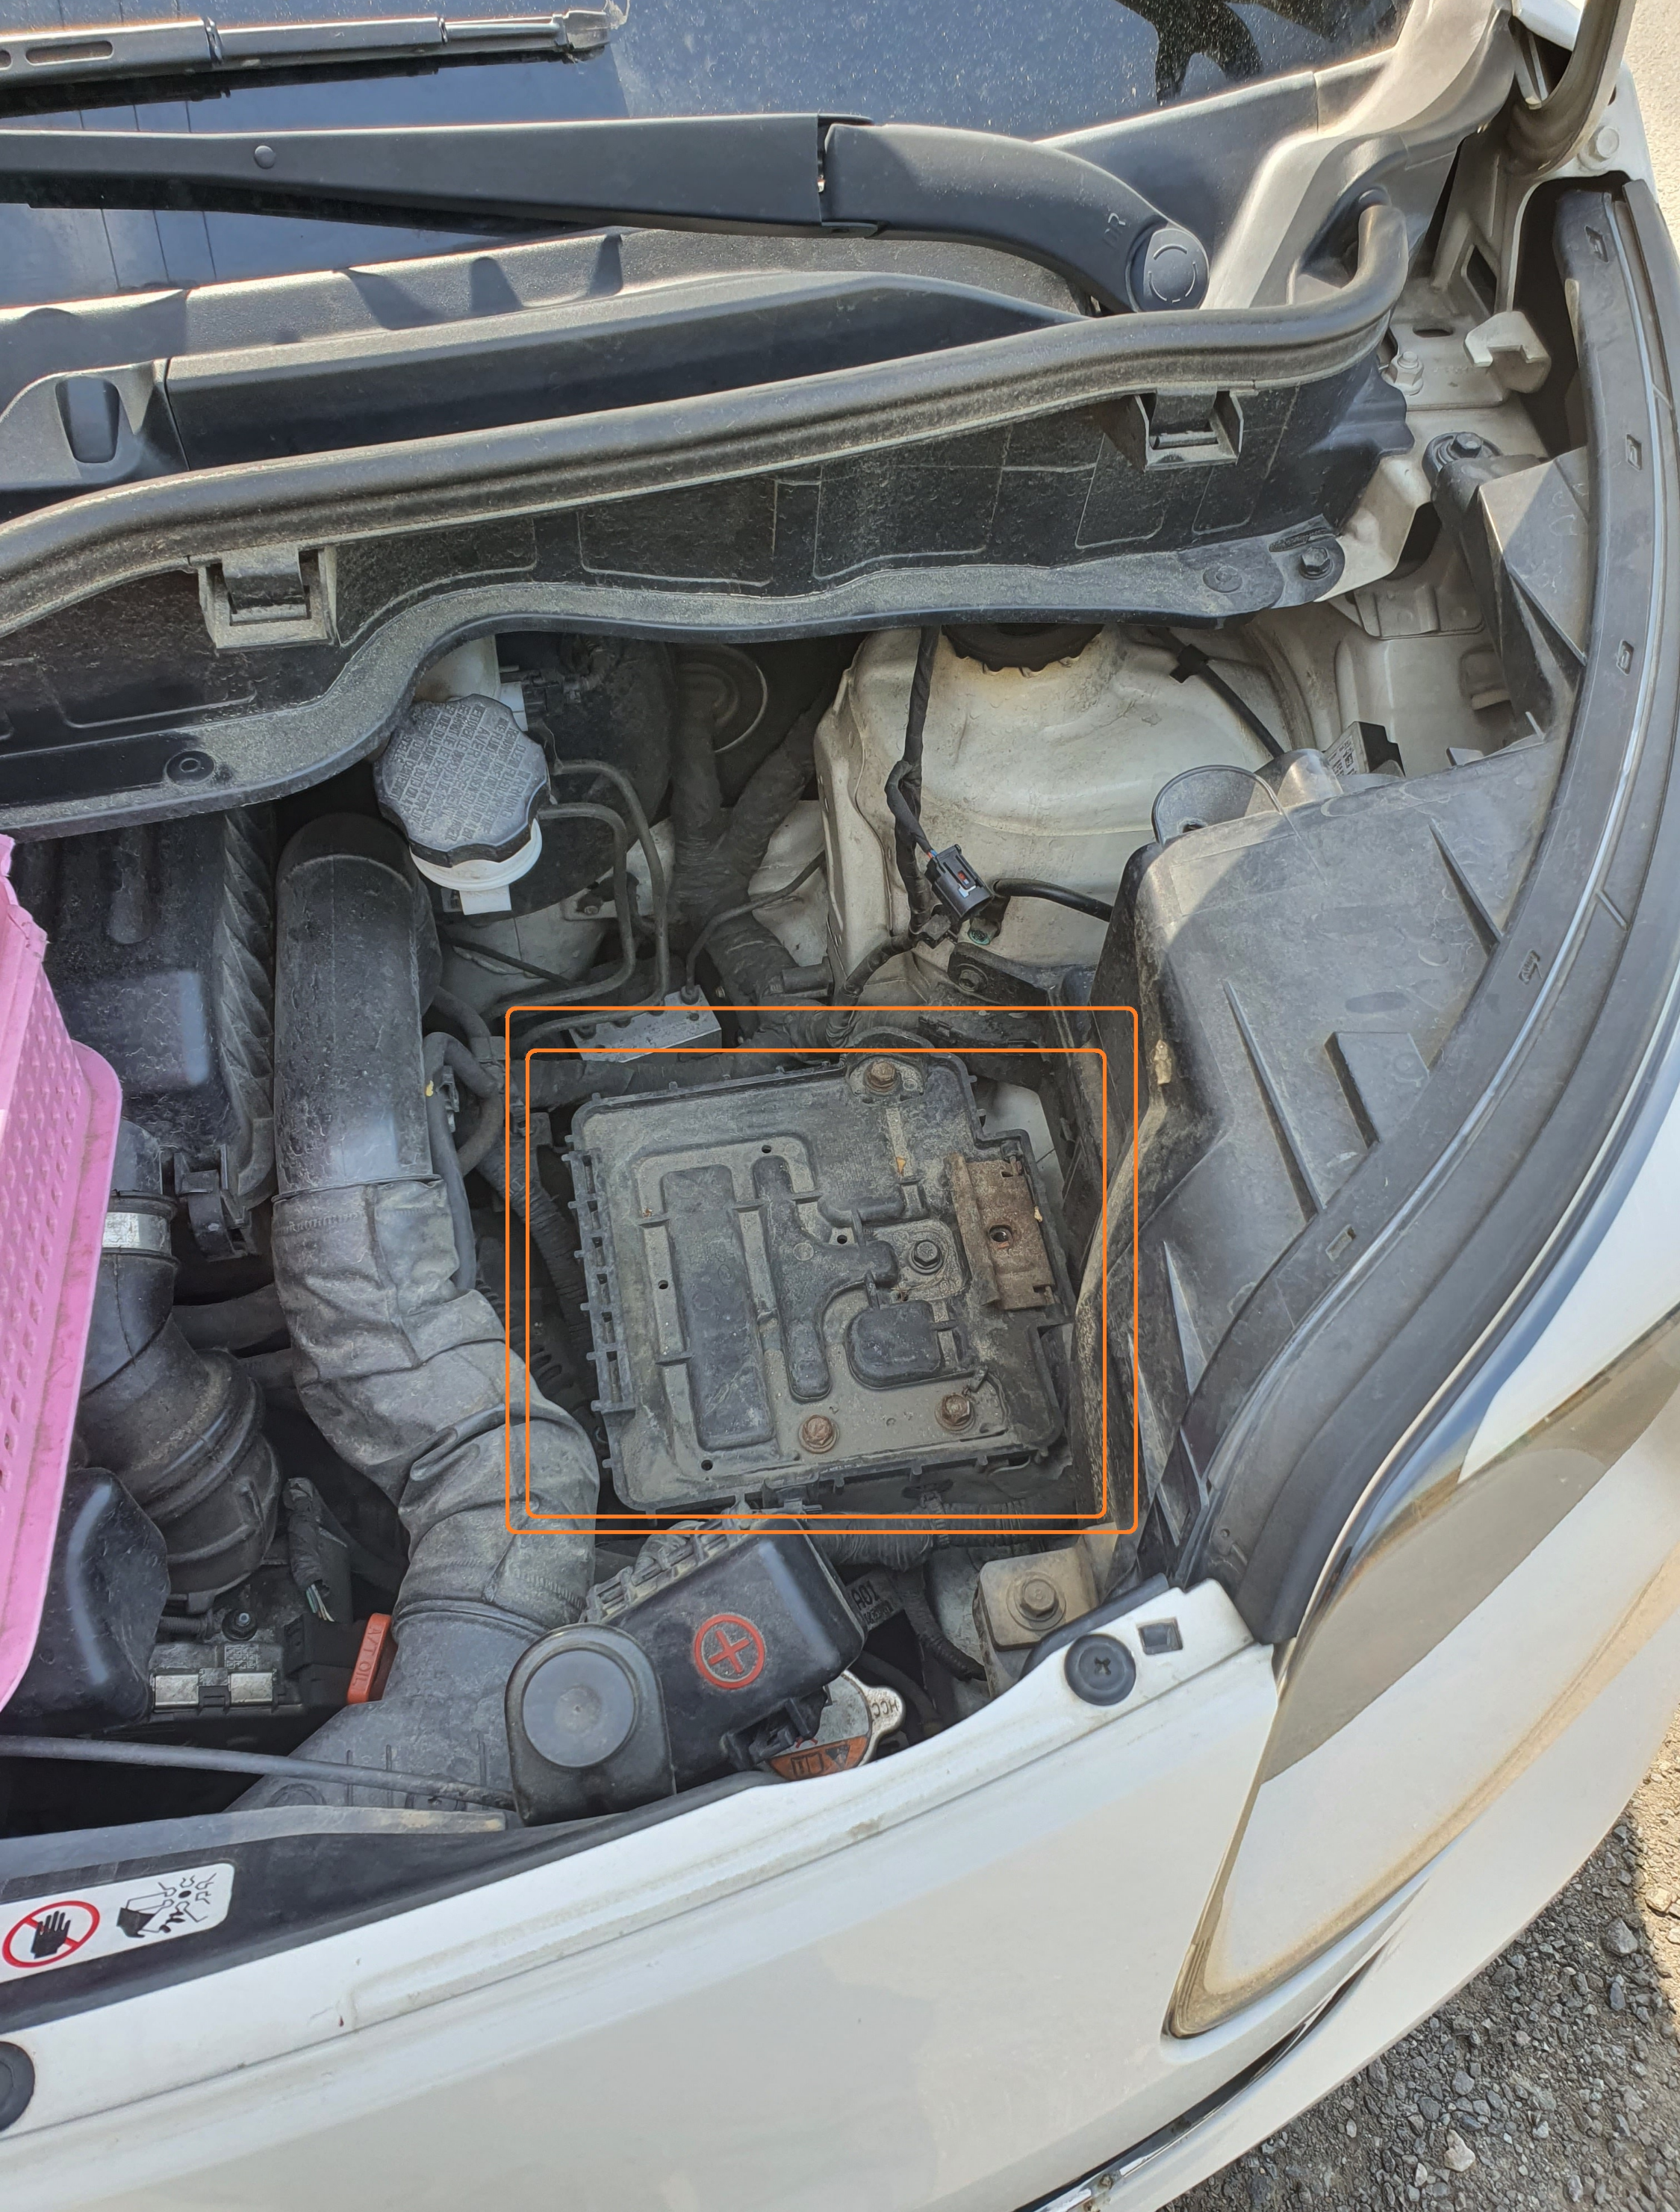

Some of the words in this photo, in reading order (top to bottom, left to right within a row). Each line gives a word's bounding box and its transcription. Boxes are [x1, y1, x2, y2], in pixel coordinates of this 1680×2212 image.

[456, 739, 469, 751] LE
[440, 727, 490, 818] AVERTISSEMENT
[503, 770, 532, 818] WARNING
[367, 1625, 382, 1656] A/T
[352, 1661, 372, 1686] OIL
[871, 1699, 898, 1717] HCC
